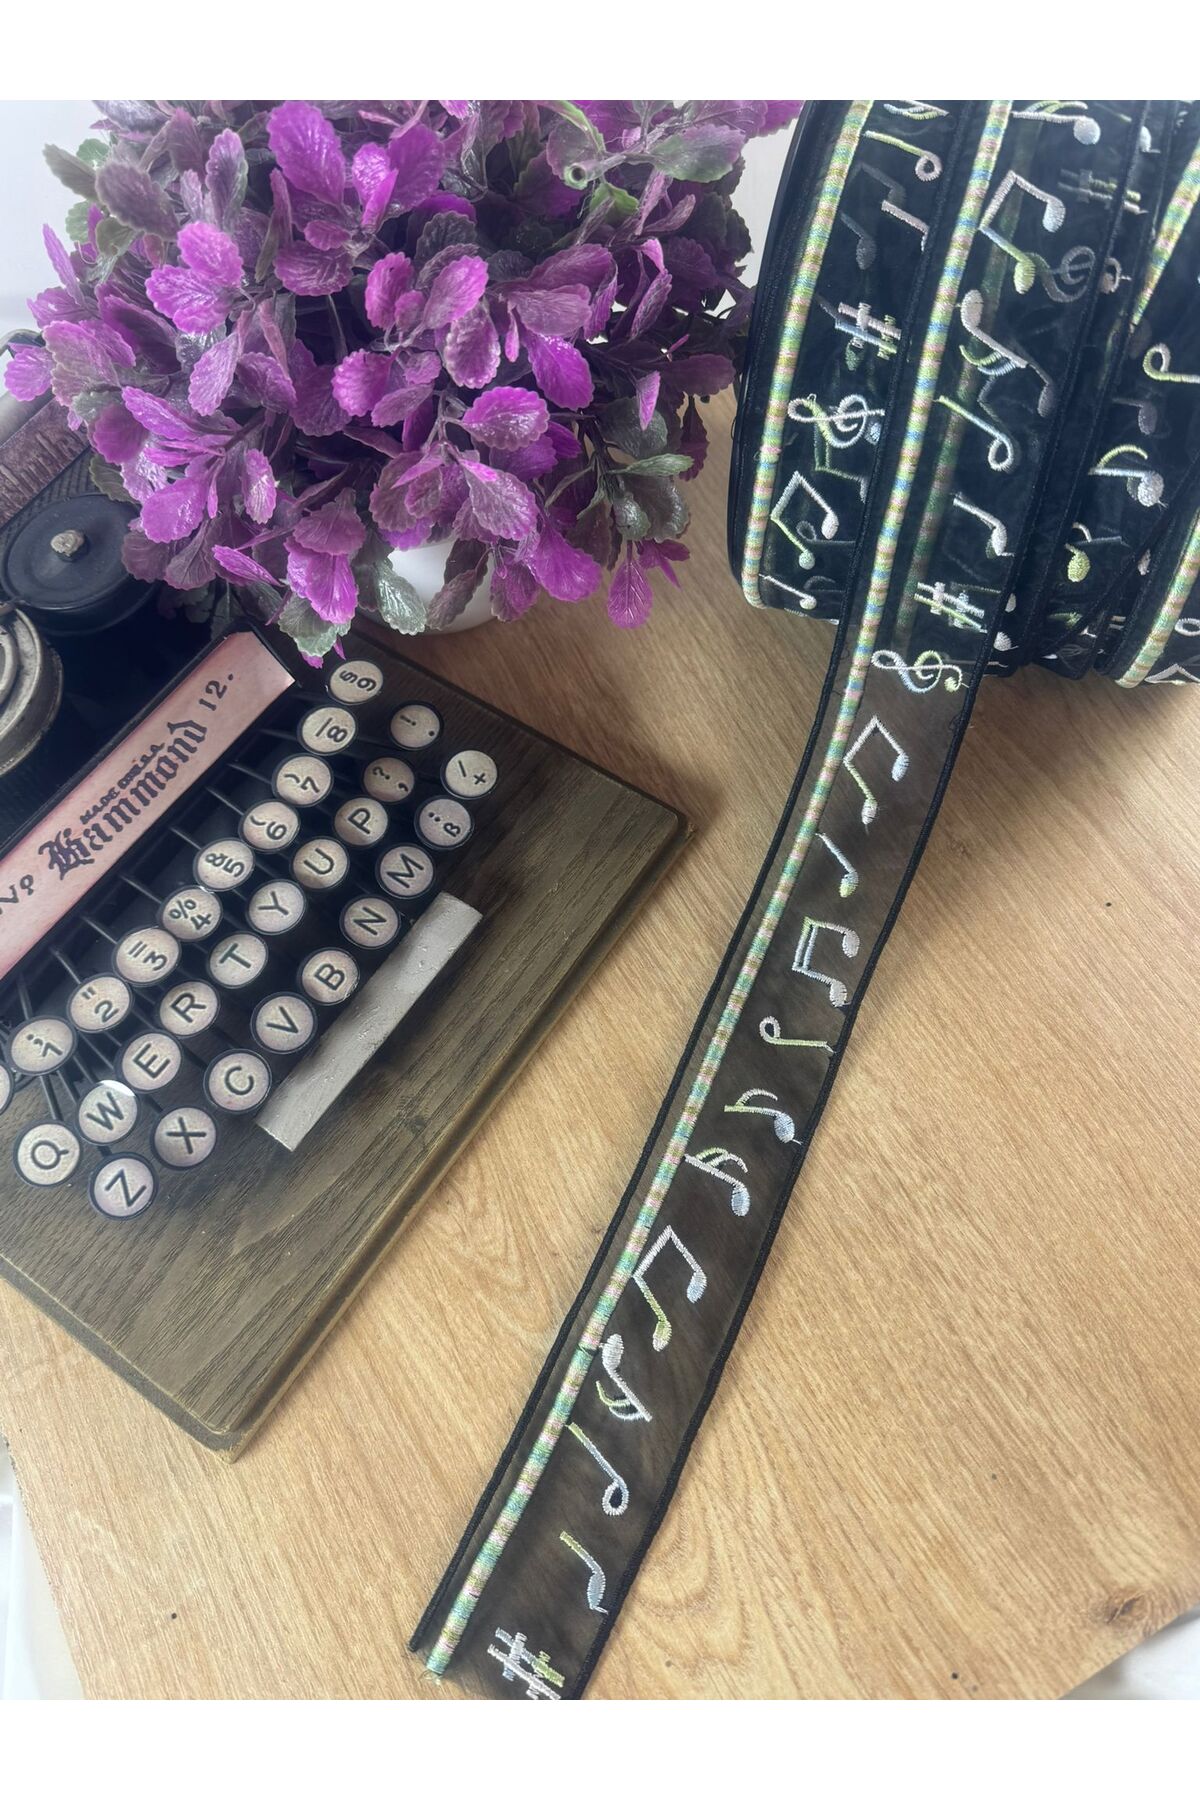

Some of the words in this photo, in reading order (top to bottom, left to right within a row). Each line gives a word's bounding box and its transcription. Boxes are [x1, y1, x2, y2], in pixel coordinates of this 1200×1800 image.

[357, 678, 376, 691] 9
[327, 726, 347, 742] 8
[301, 777, 320, 793] 7
[38, 719, 208, 881] Hammond
[267, 822, 287, 840] 6
[348, 808, 370, 834] P
[206, 854, 227, 867] &
[223, 859, 244, 877] 5
[304, 848, 334, 874] U
[387, 854, 424, 888] M
[170, 900, 196, 919] %
[191, 914, 211, 930] 4
[258, 891, 288, 915] Y
[354, 907, 386, 935] N
[143, 952, 167, 971] 3
[219, 939, 251, 968] T
[315, 964, 344, 990] B
[95, 1001, 119, 1023] 2
[170, 992, 206, 1022] R
[267, 1007, 299, 1033] V
[133, 1044, 170, 1078] E
[225, 1066, 254, 1095] C
[87, 1092, 124, 1130] W
[167, 1118, 206, 1154] X
[31, 1141, 69, 1170] Q
[106, 1170, 146, 1207] Z
